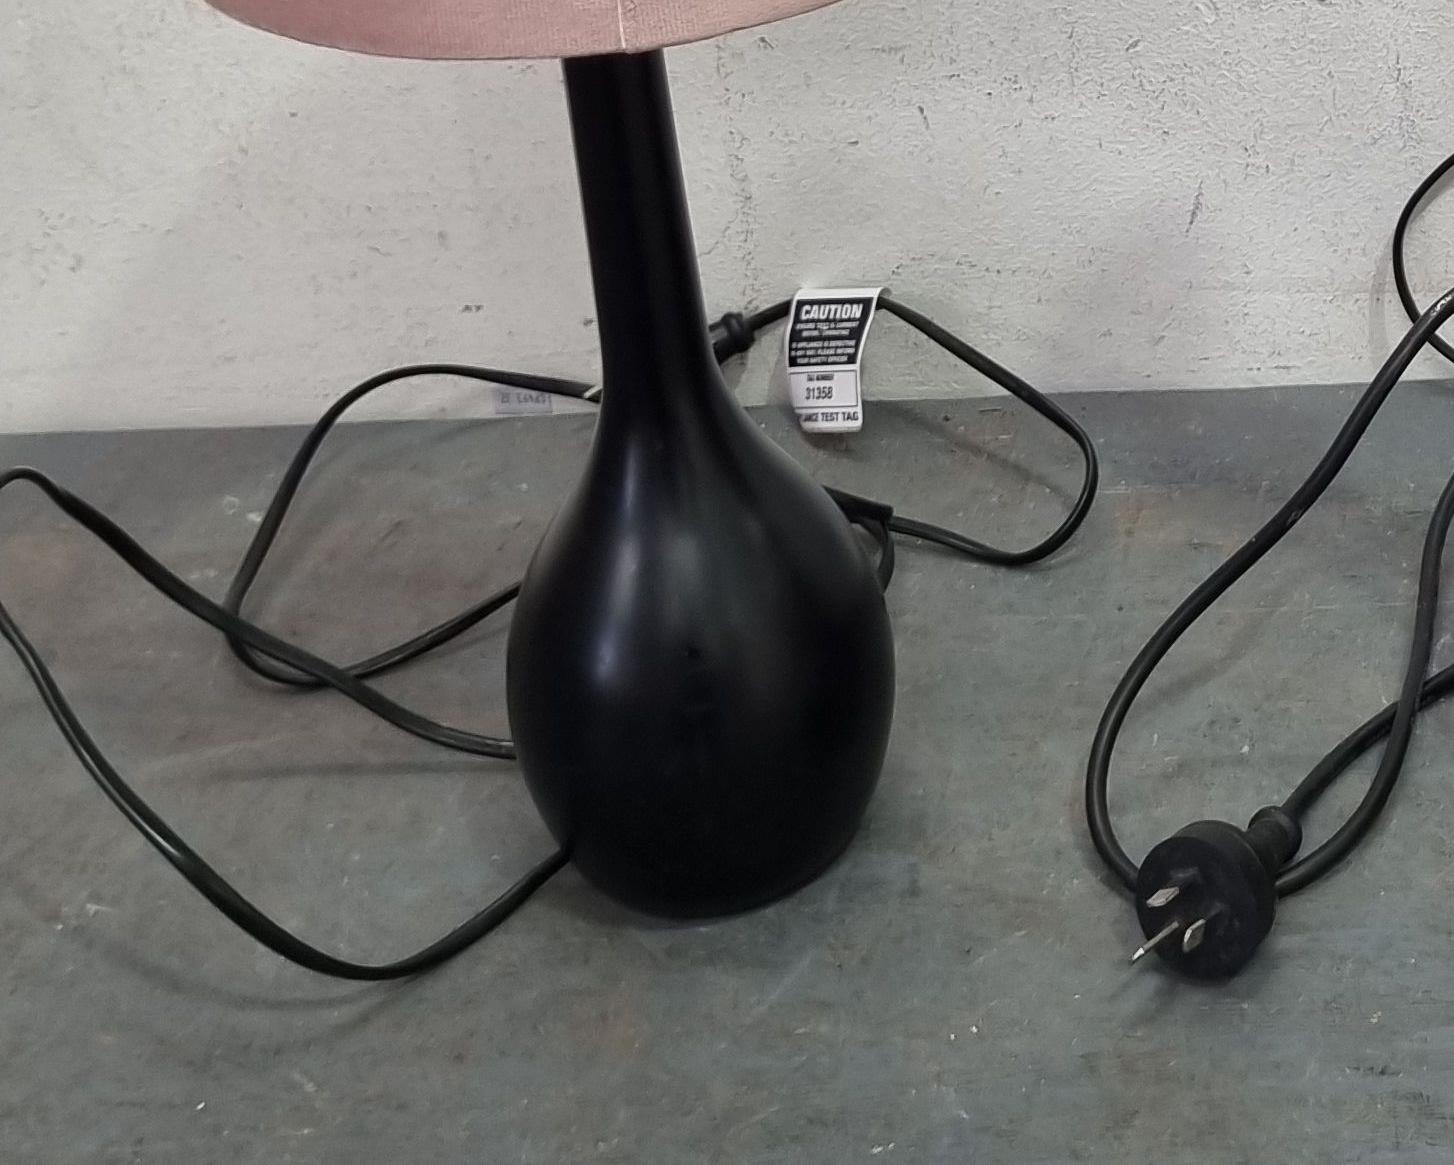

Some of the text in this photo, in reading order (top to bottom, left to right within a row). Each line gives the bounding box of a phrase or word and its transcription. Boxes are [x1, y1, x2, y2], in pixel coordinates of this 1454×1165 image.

[800, 303, 863, 320] CAUTION
[805, 386, 833, 400] 31358
[820, 412, 839, 422] TEST
[841, 411, 859, 422] TAG
